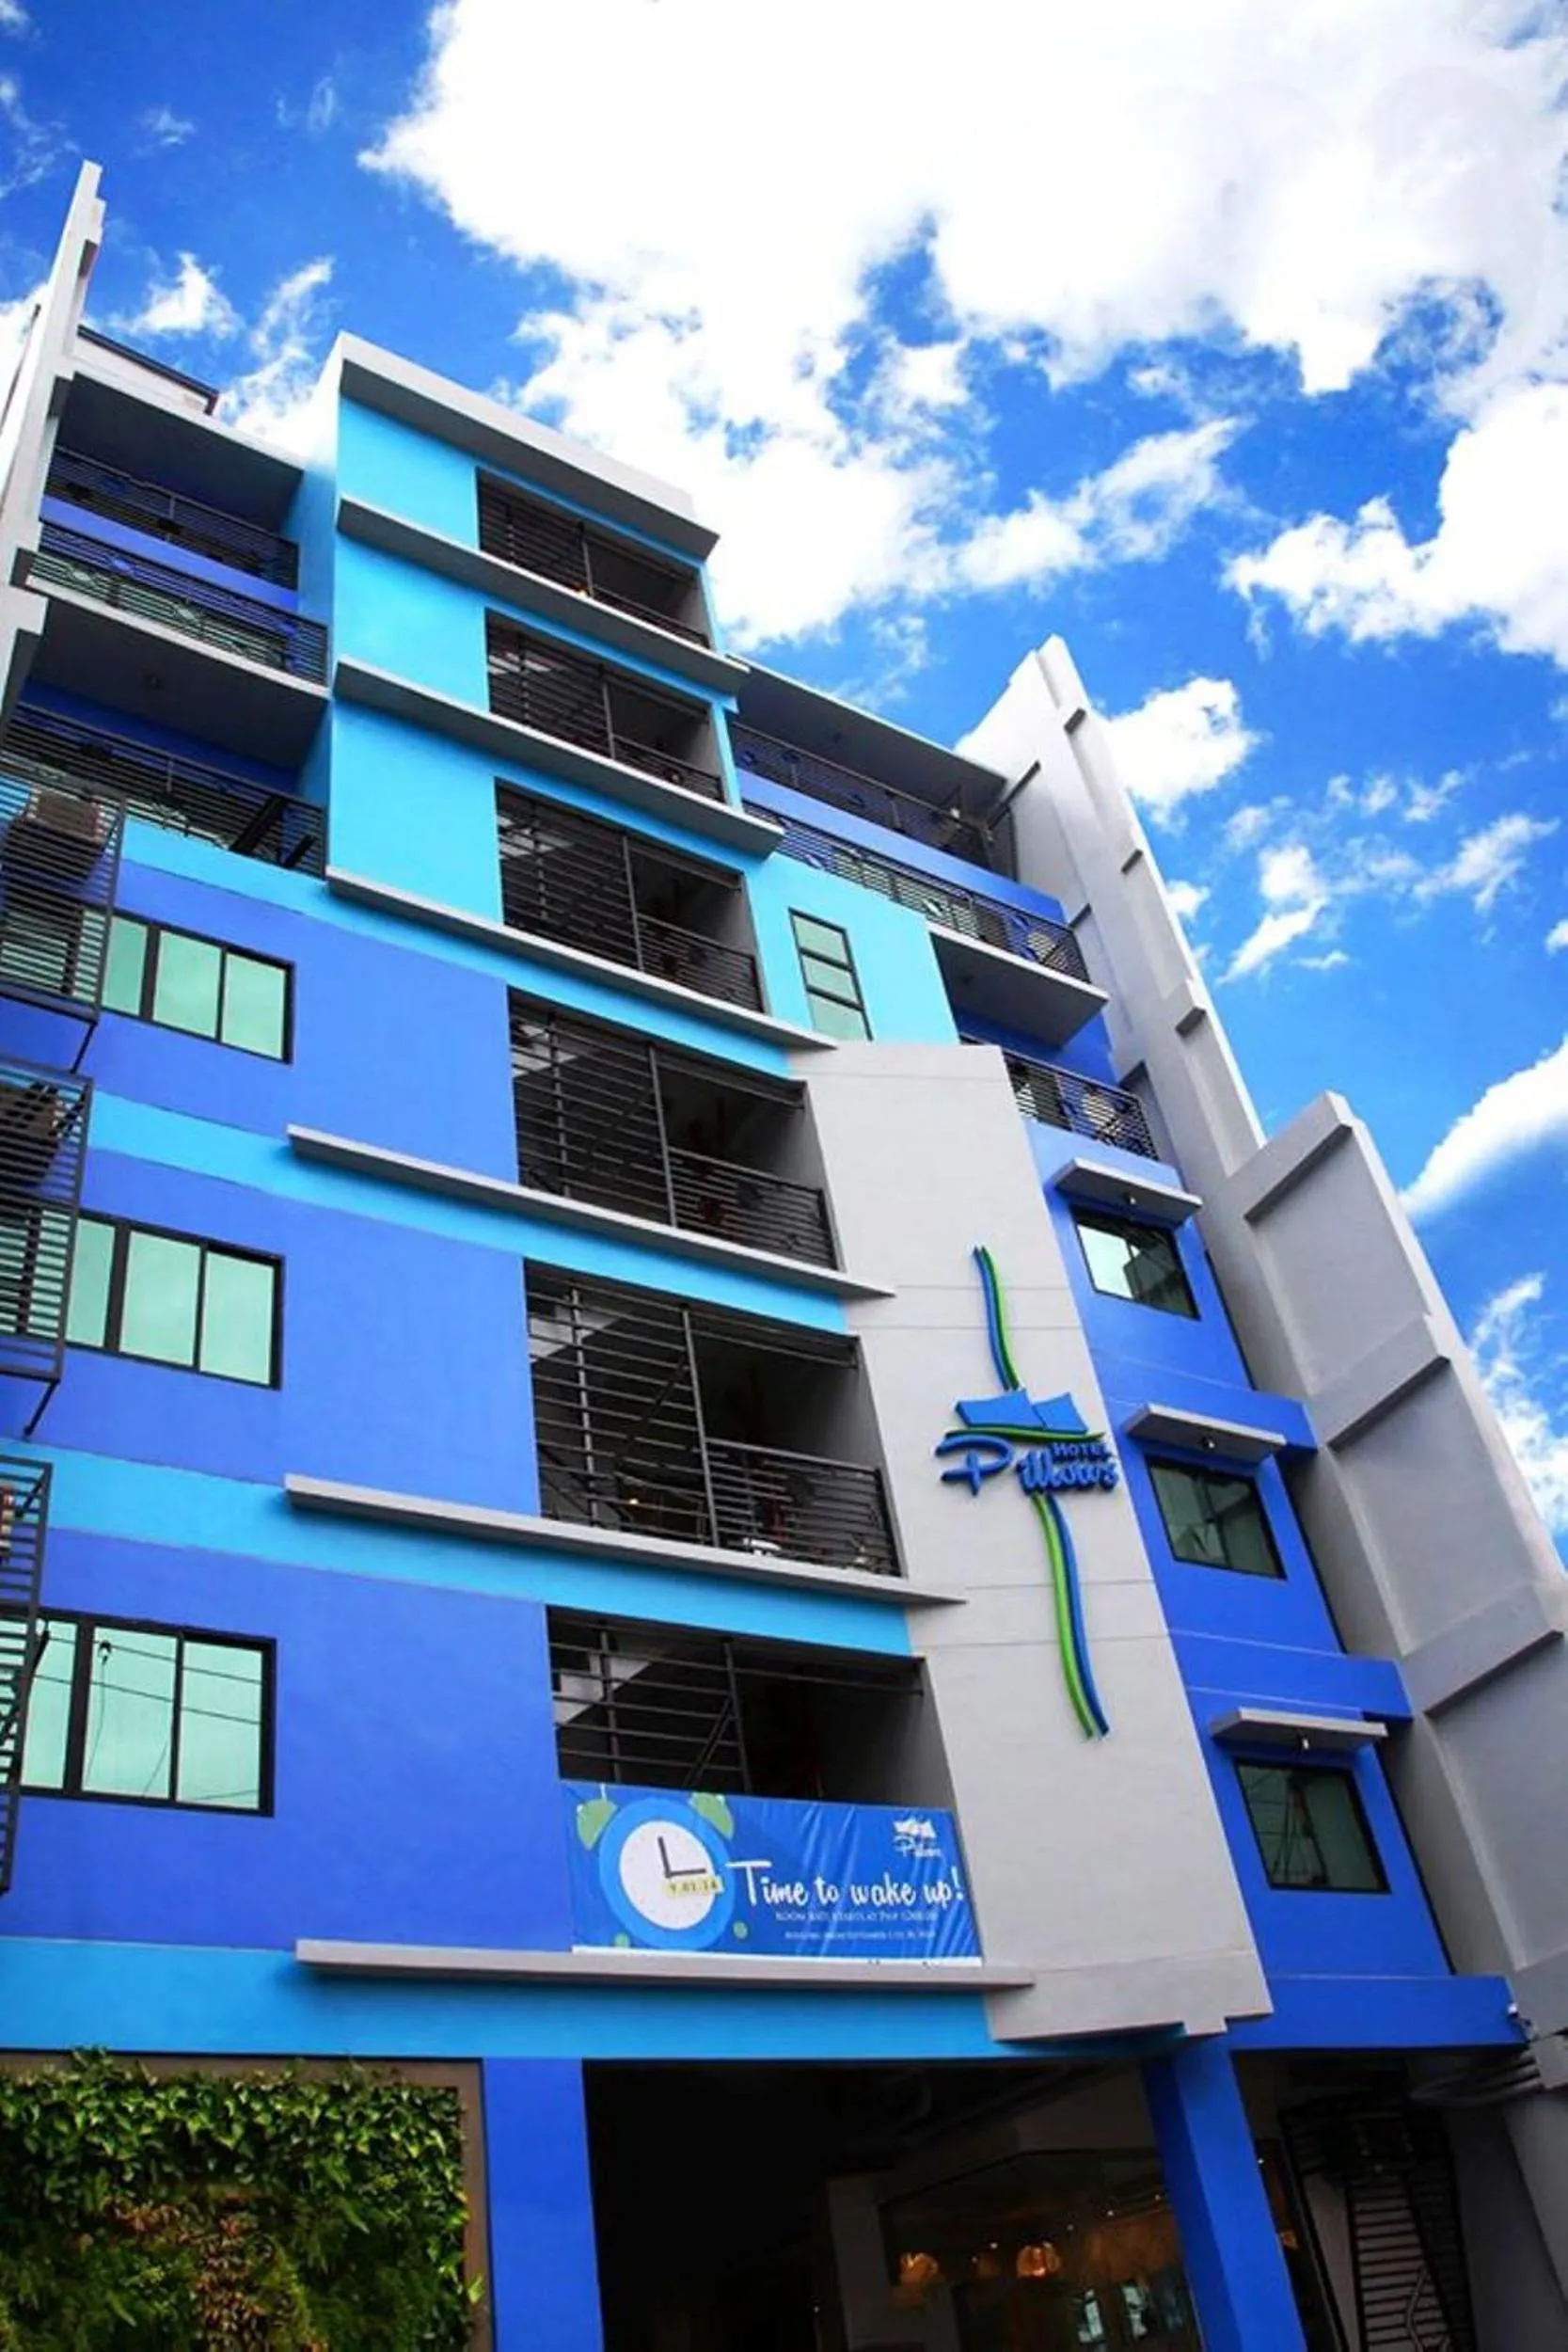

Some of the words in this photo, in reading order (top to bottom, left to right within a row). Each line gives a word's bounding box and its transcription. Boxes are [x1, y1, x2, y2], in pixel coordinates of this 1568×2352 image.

[1051, 1441, 1112, 1462] HOTEL
[726, 1859, 808, 1906] Time
[815, 1874, 840, 1903] to
[851, 1872, 916, 1906] wake
[924, 1867, 964, 1908] up!
